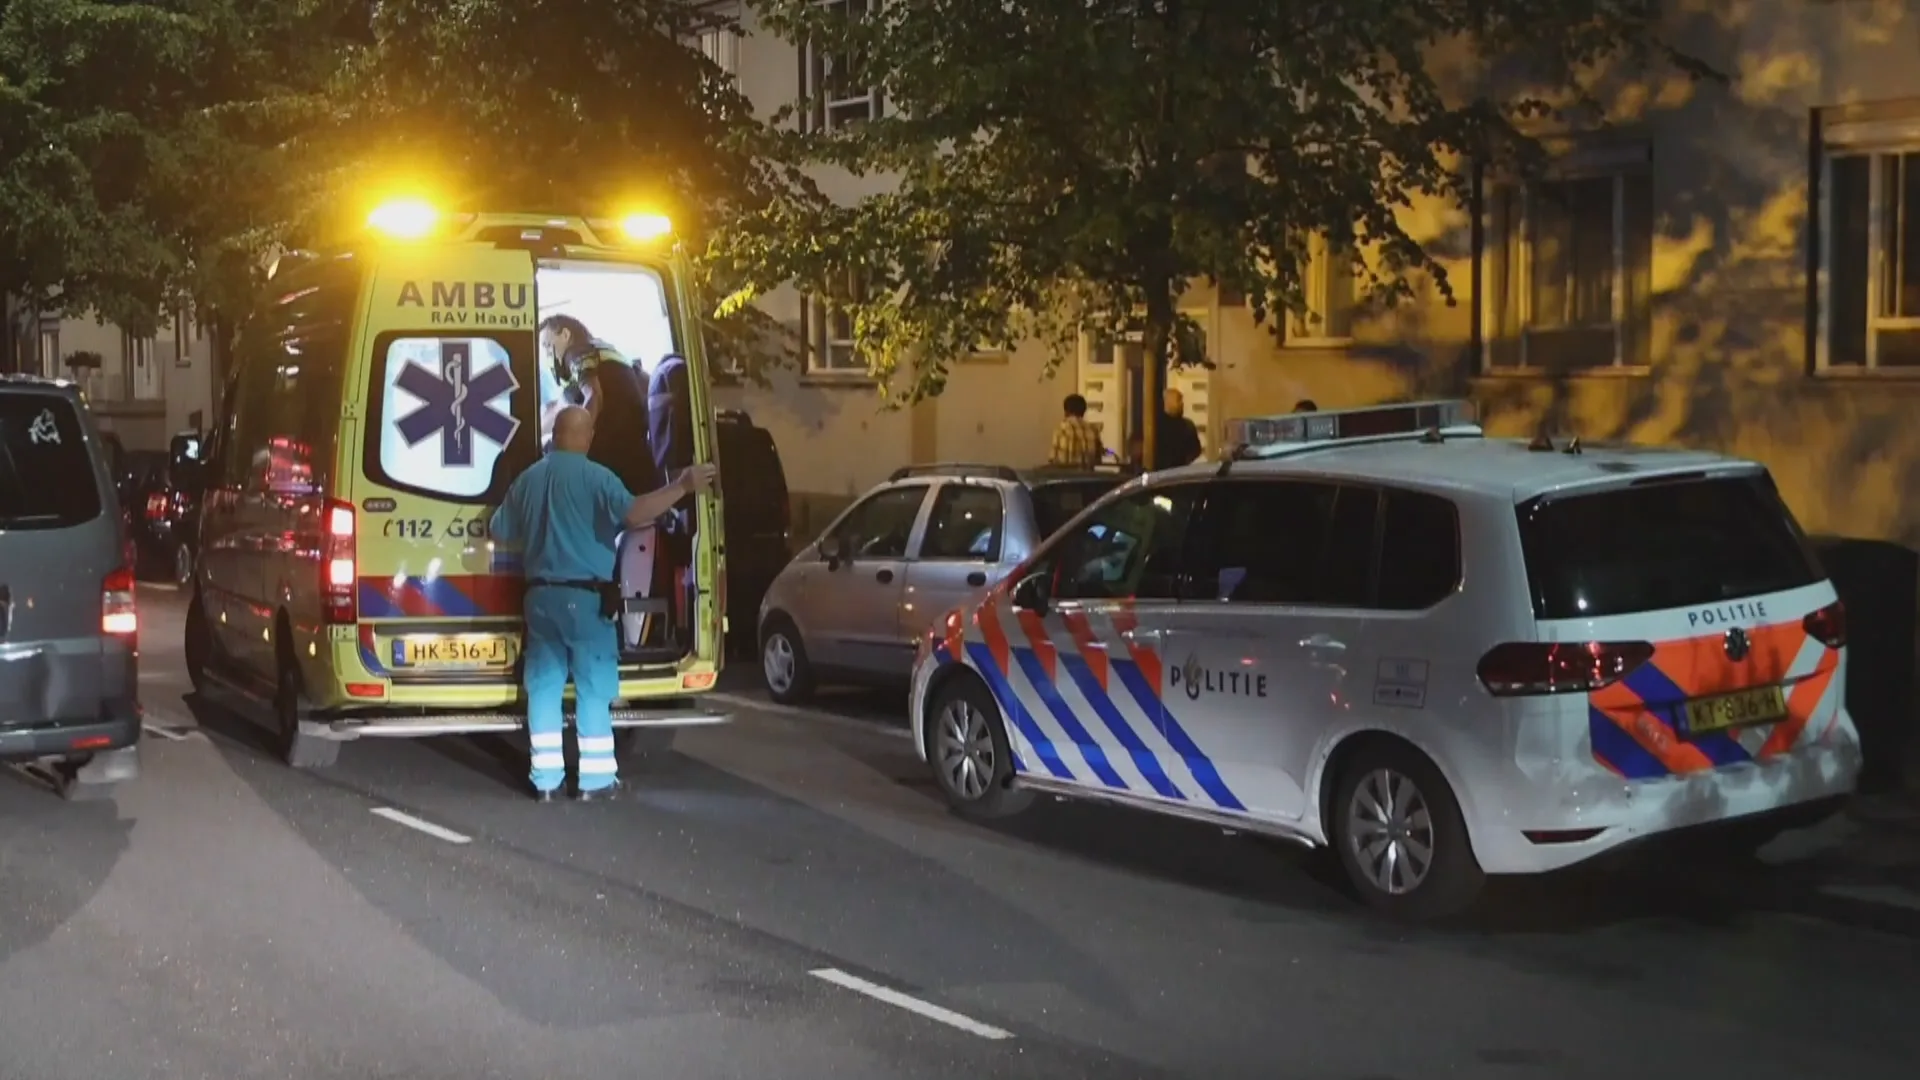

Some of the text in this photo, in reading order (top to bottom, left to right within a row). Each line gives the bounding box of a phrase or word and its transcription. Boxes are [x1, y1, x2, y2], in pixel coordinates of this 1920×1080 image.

[396, 281, 527, 309] AMBU
[431, 311, 468, 324] RAV
[446, 516, 490, 538] GG
[1688, 601, 1767, 628] POLITIE
[413, 641, 497, 660] HK-516-J
